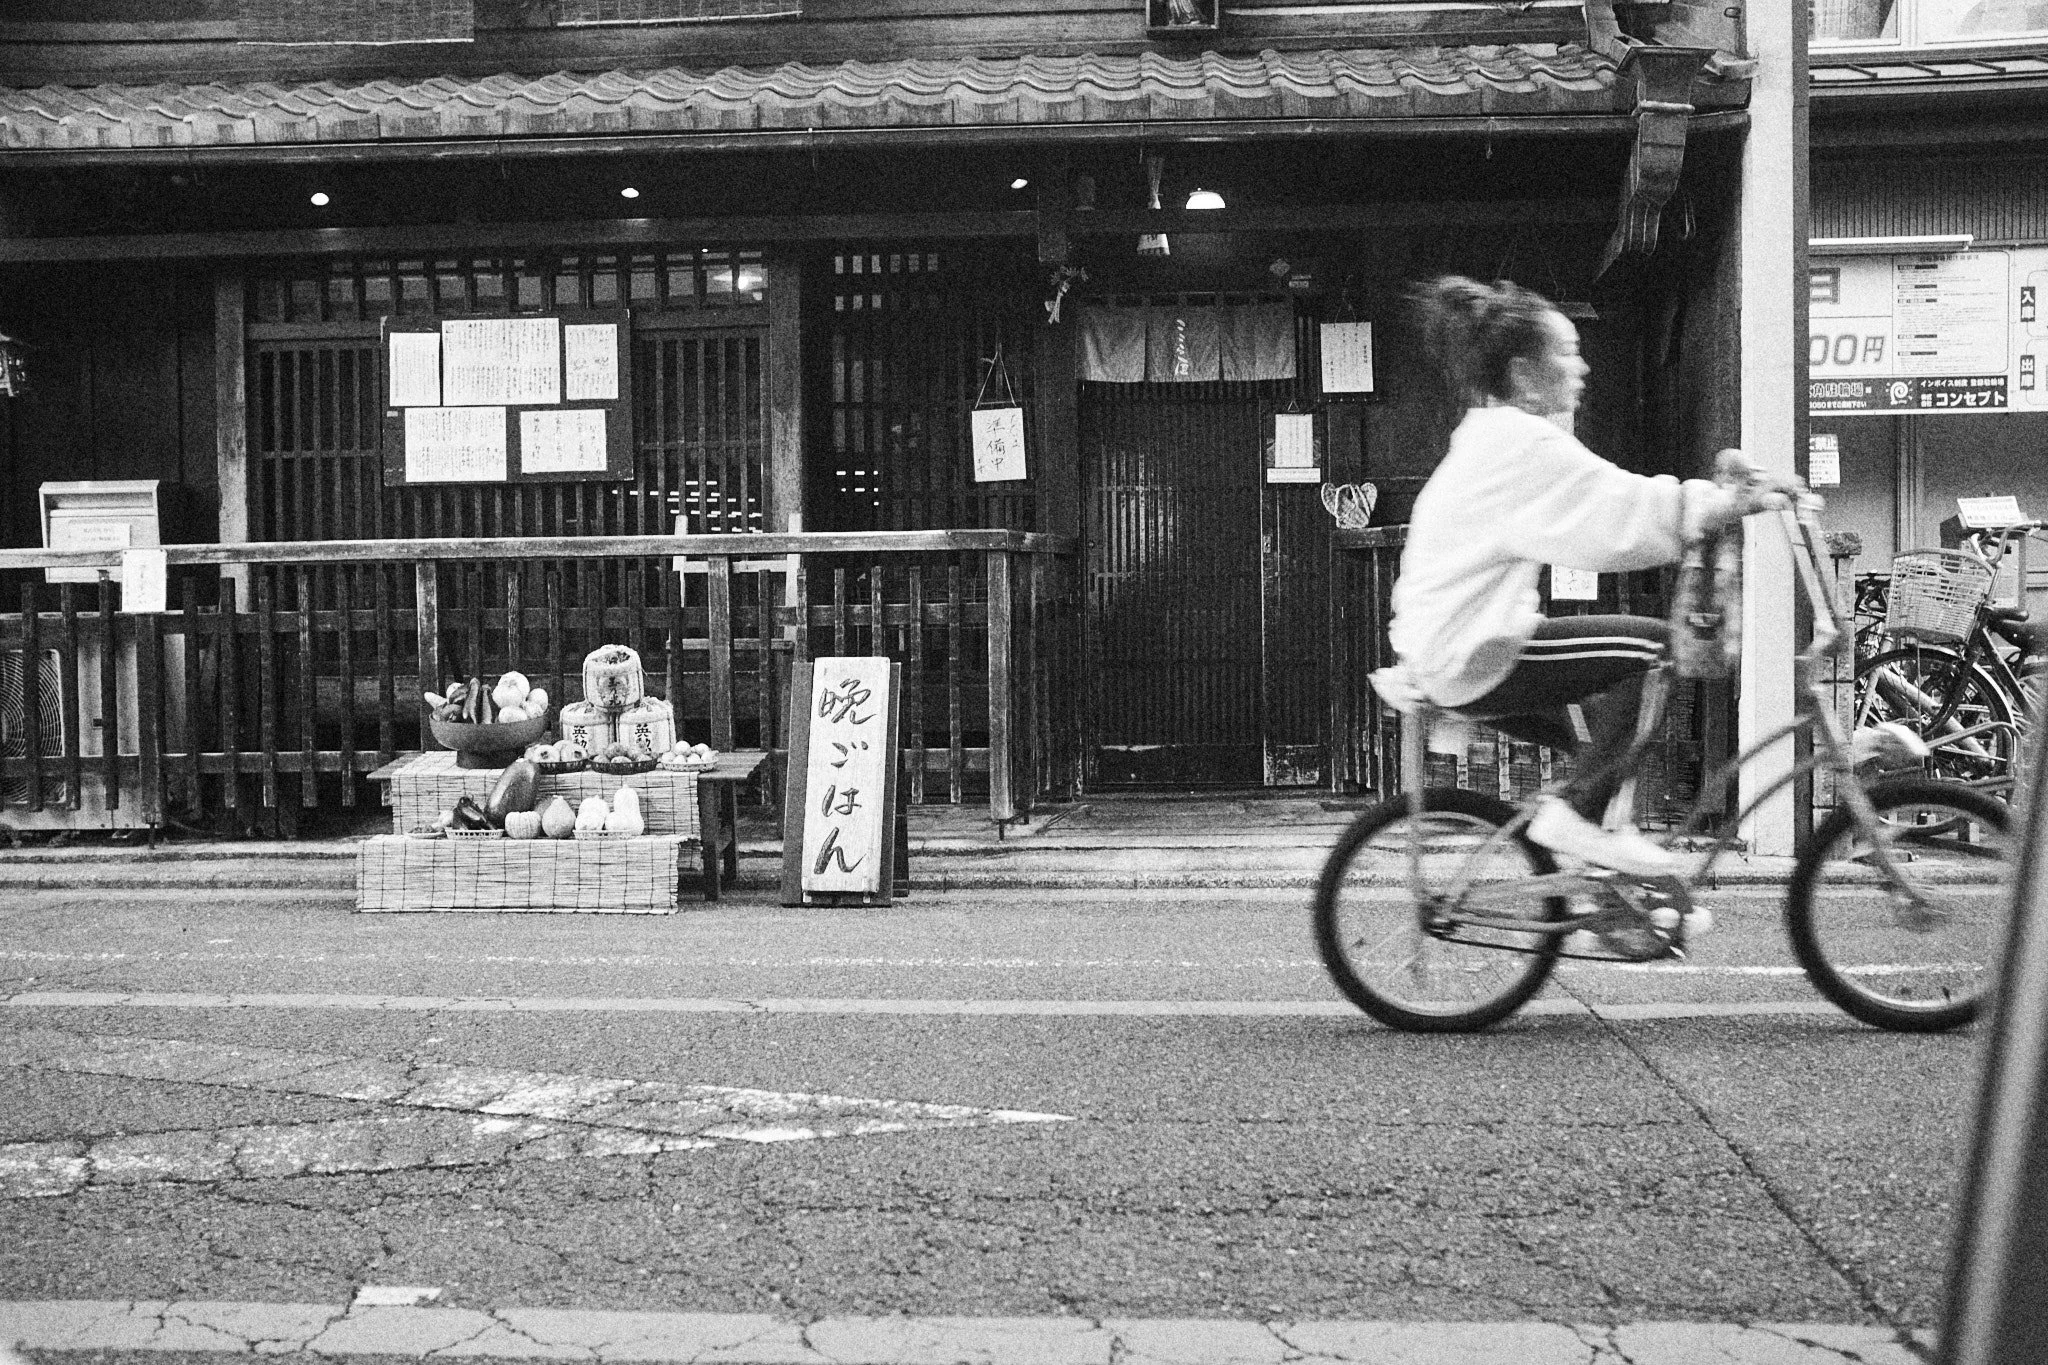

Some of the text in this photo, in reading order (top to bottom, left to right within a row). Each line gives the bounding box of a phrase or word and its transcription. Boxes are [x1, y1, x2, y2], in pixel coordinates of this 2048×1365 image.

[1936, 390, 2006, 407] コンセプト
[813, 678, 877, 875] 晩ごはん
